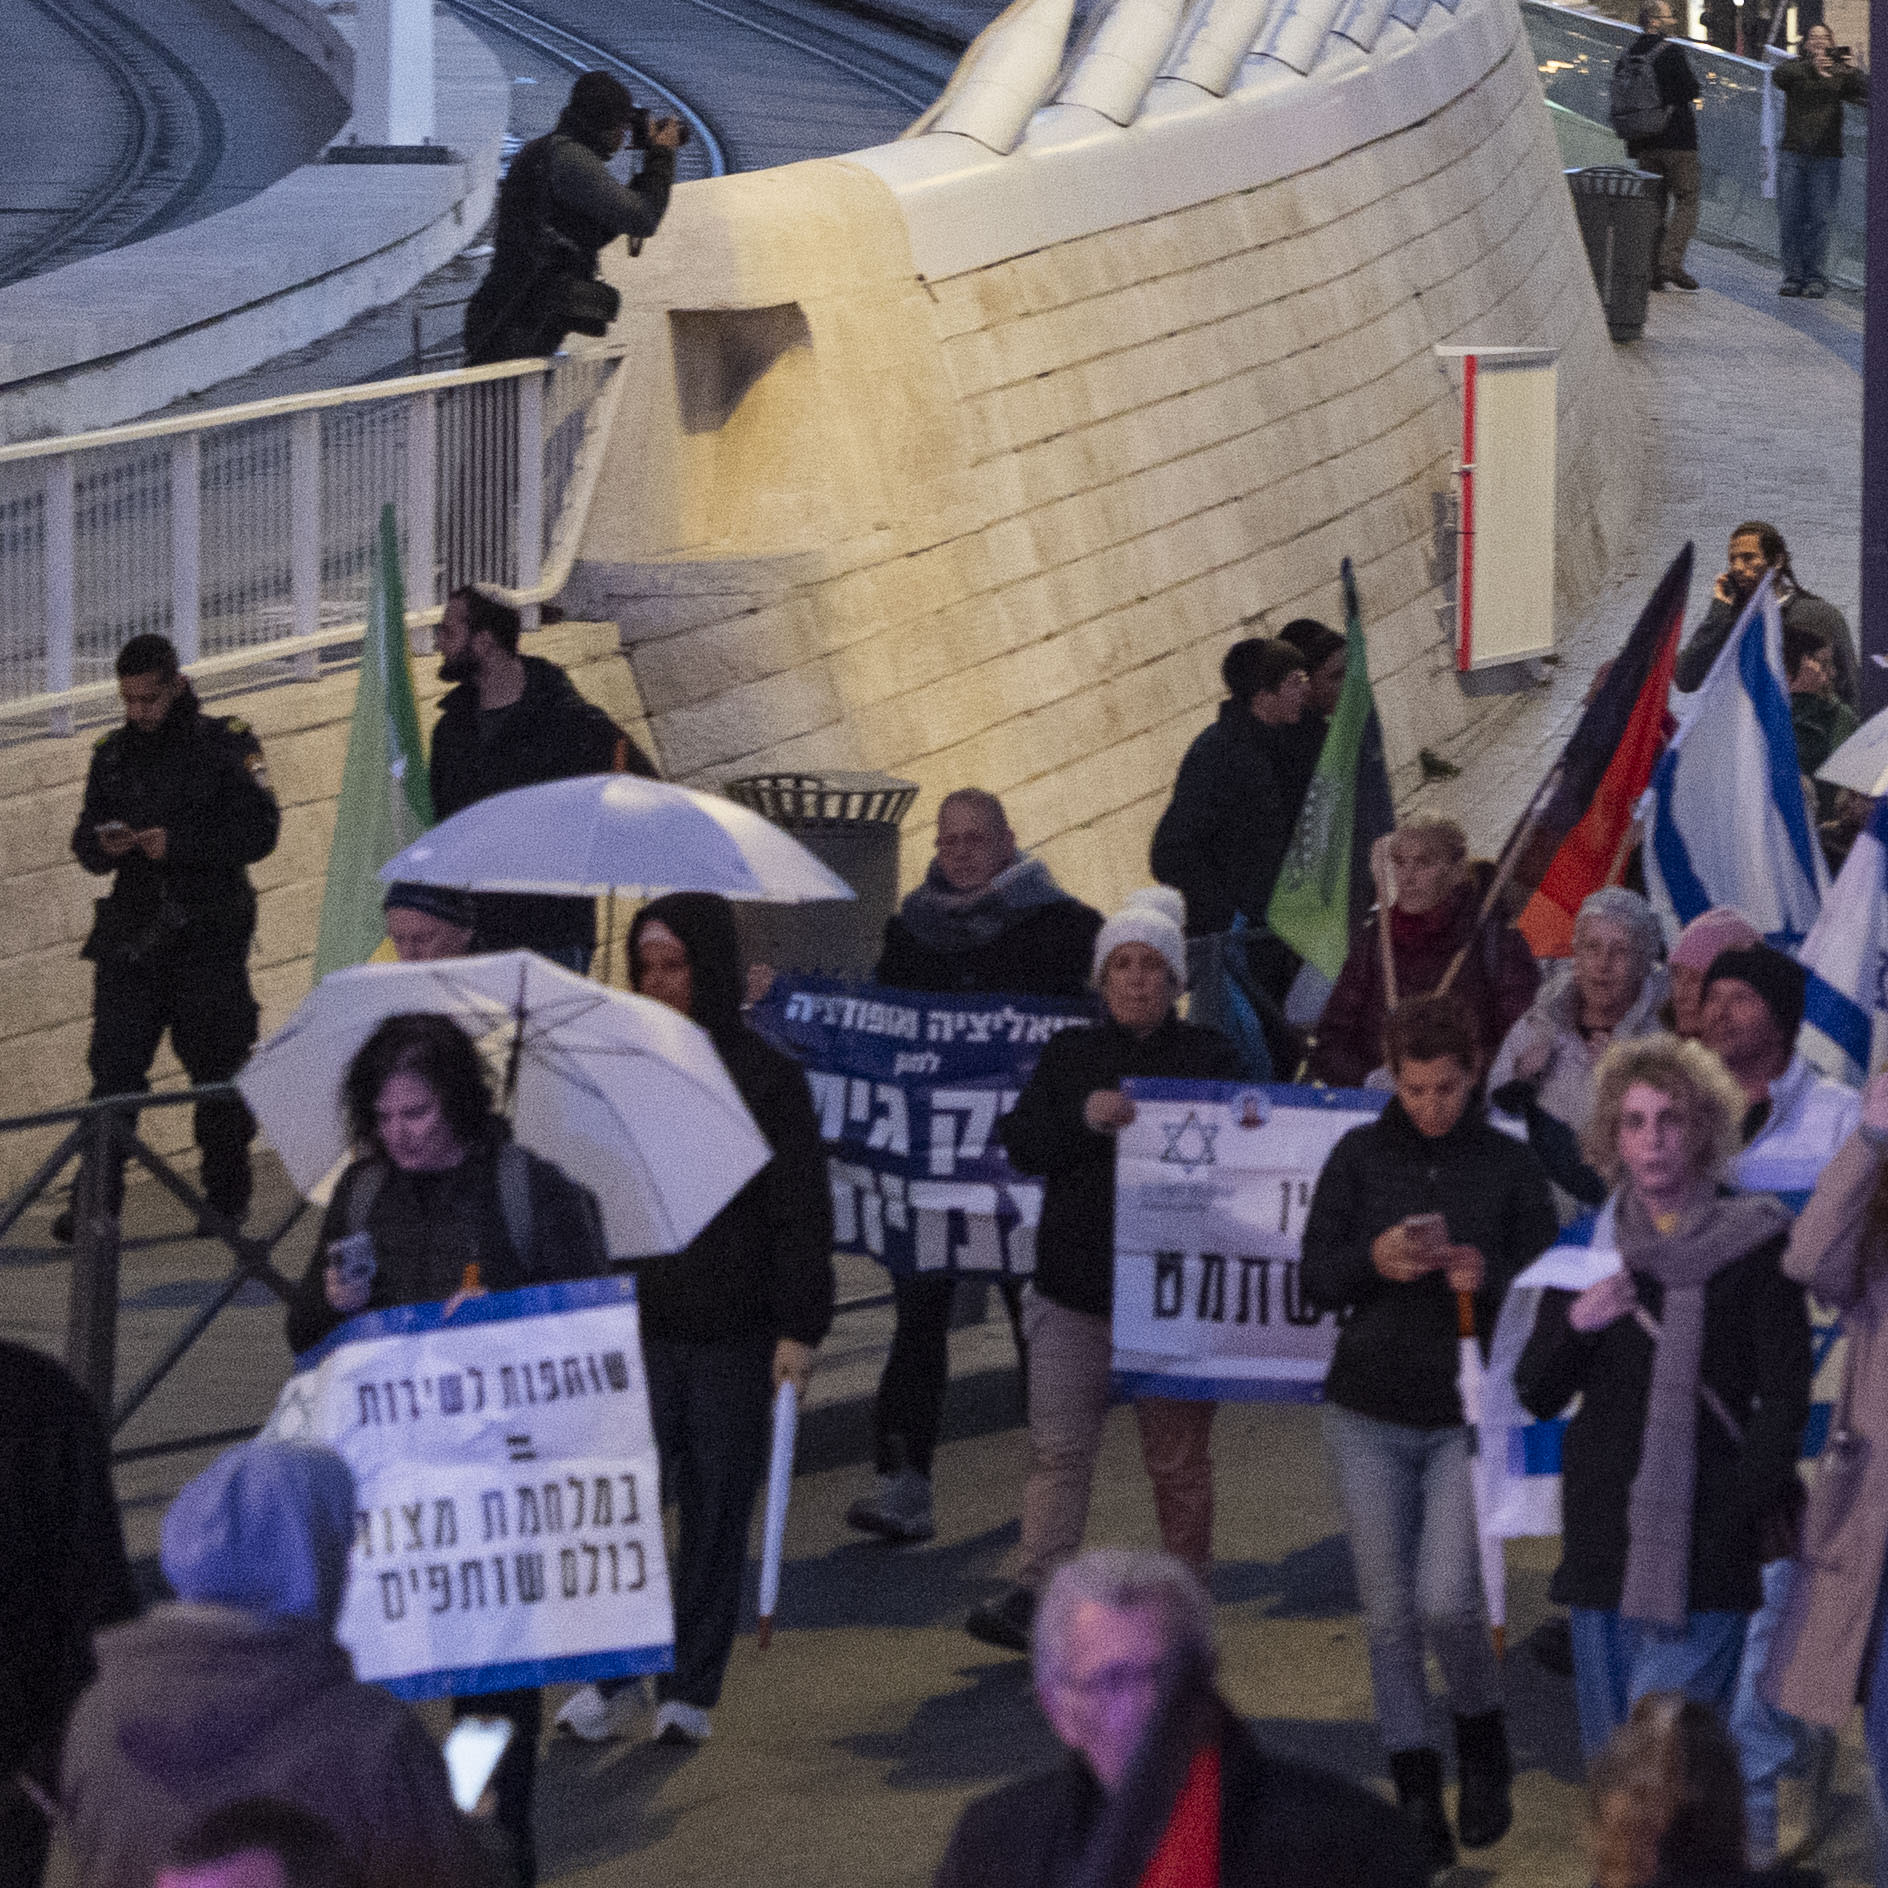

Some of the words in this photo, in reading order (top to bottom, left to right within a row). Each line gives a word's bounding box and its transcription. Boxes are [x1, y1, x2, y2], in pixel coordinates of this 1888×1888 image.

[355, 1366, 488, 1429] לשירות
[499, 1348, 631, 1411] שותפות
[480, 1472, 642, 1543] במלחמת
[378, 1551, 547, 1622] שותפים
[558, 1539, 649, 1600] כולם
